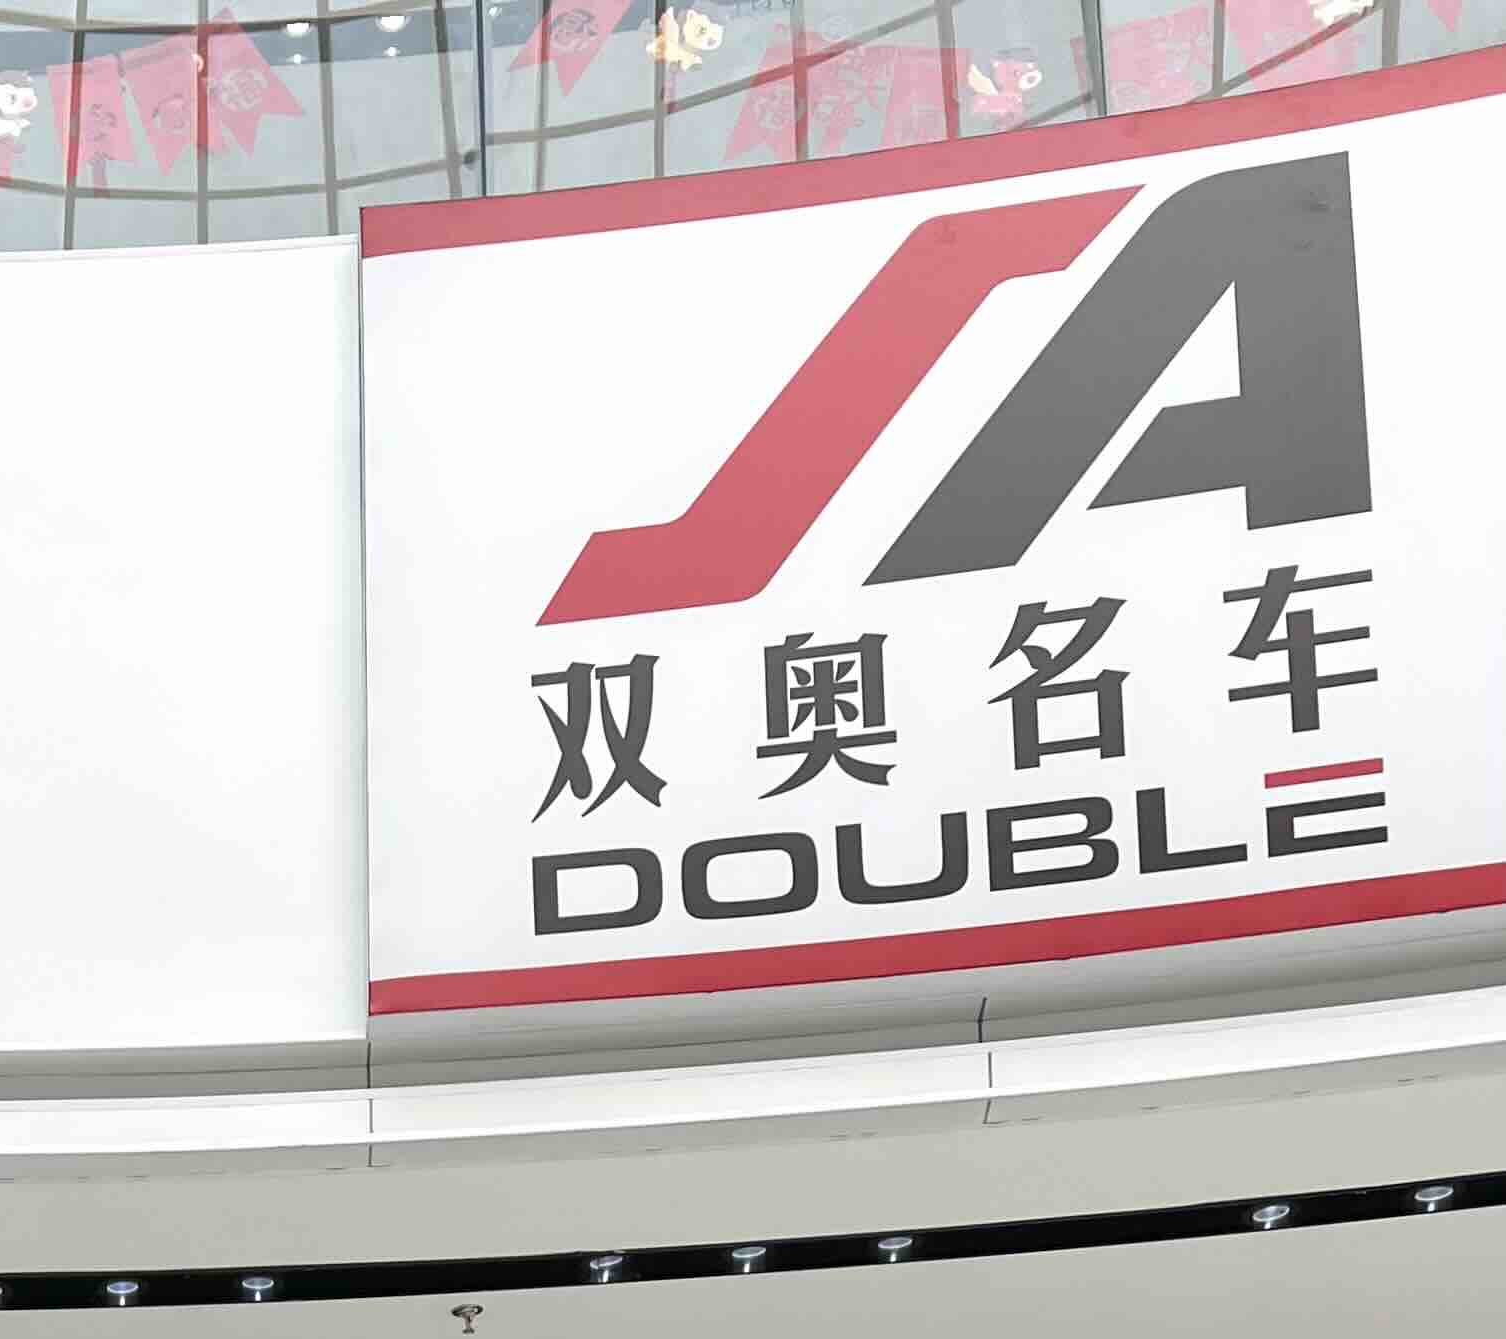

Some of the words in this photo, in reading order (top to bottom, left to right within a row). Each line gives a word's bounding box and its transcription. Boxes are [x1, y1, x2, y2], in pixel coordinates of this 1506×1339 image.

[531, 564, 1378, 823] 双奥名车
[532, 757, 1388, 936] DOUBLE
